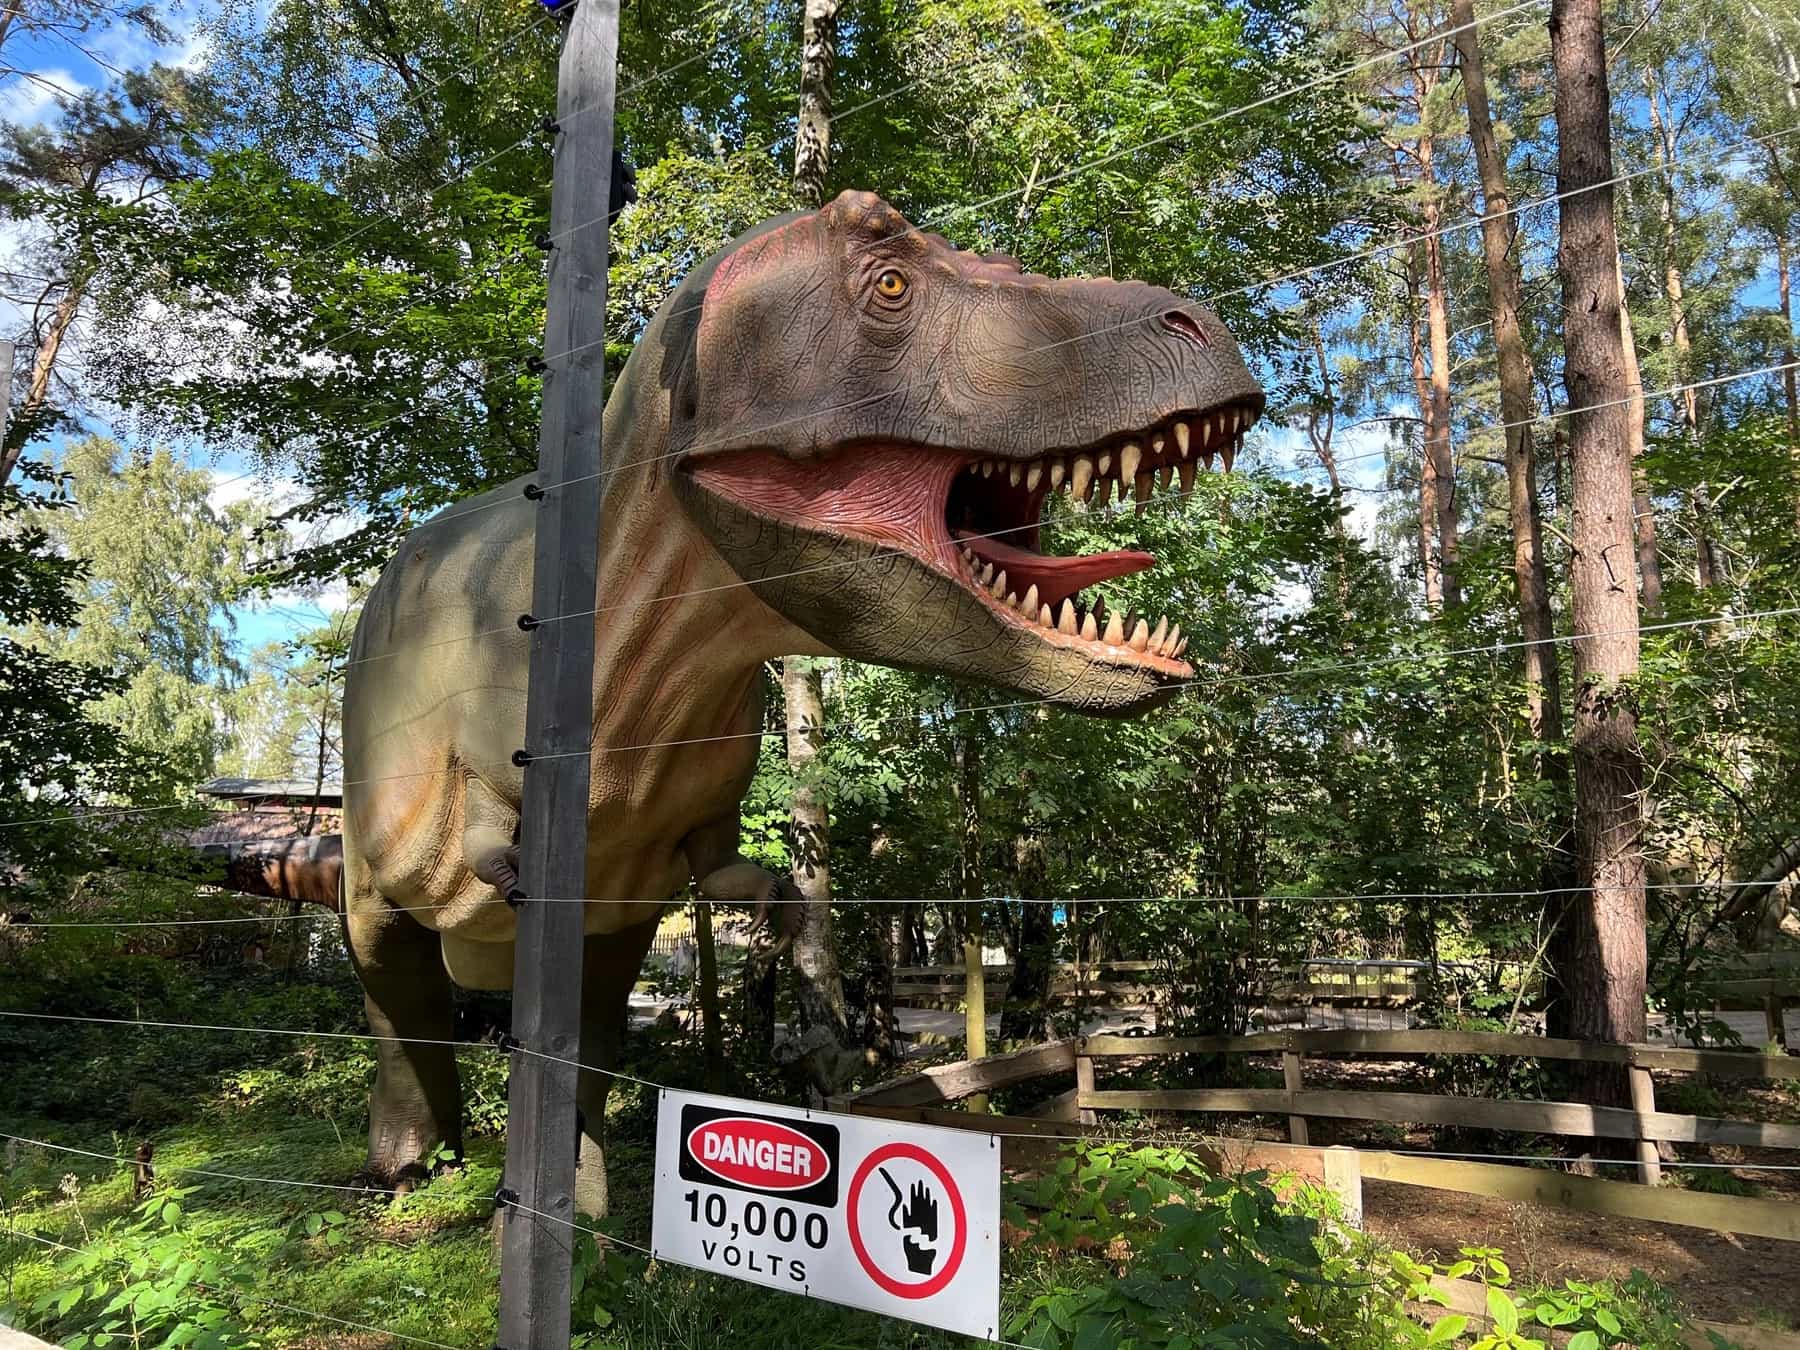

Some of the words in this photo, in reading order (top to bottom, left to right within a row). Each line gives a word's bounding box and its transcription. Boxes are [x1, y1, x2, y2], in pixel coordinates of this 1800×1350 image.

[703, 1132, 812, 1177] DANGER
[685, 1189, 829, 1250] 10,000
[702, 1240, 807, 1282] VOLTS
